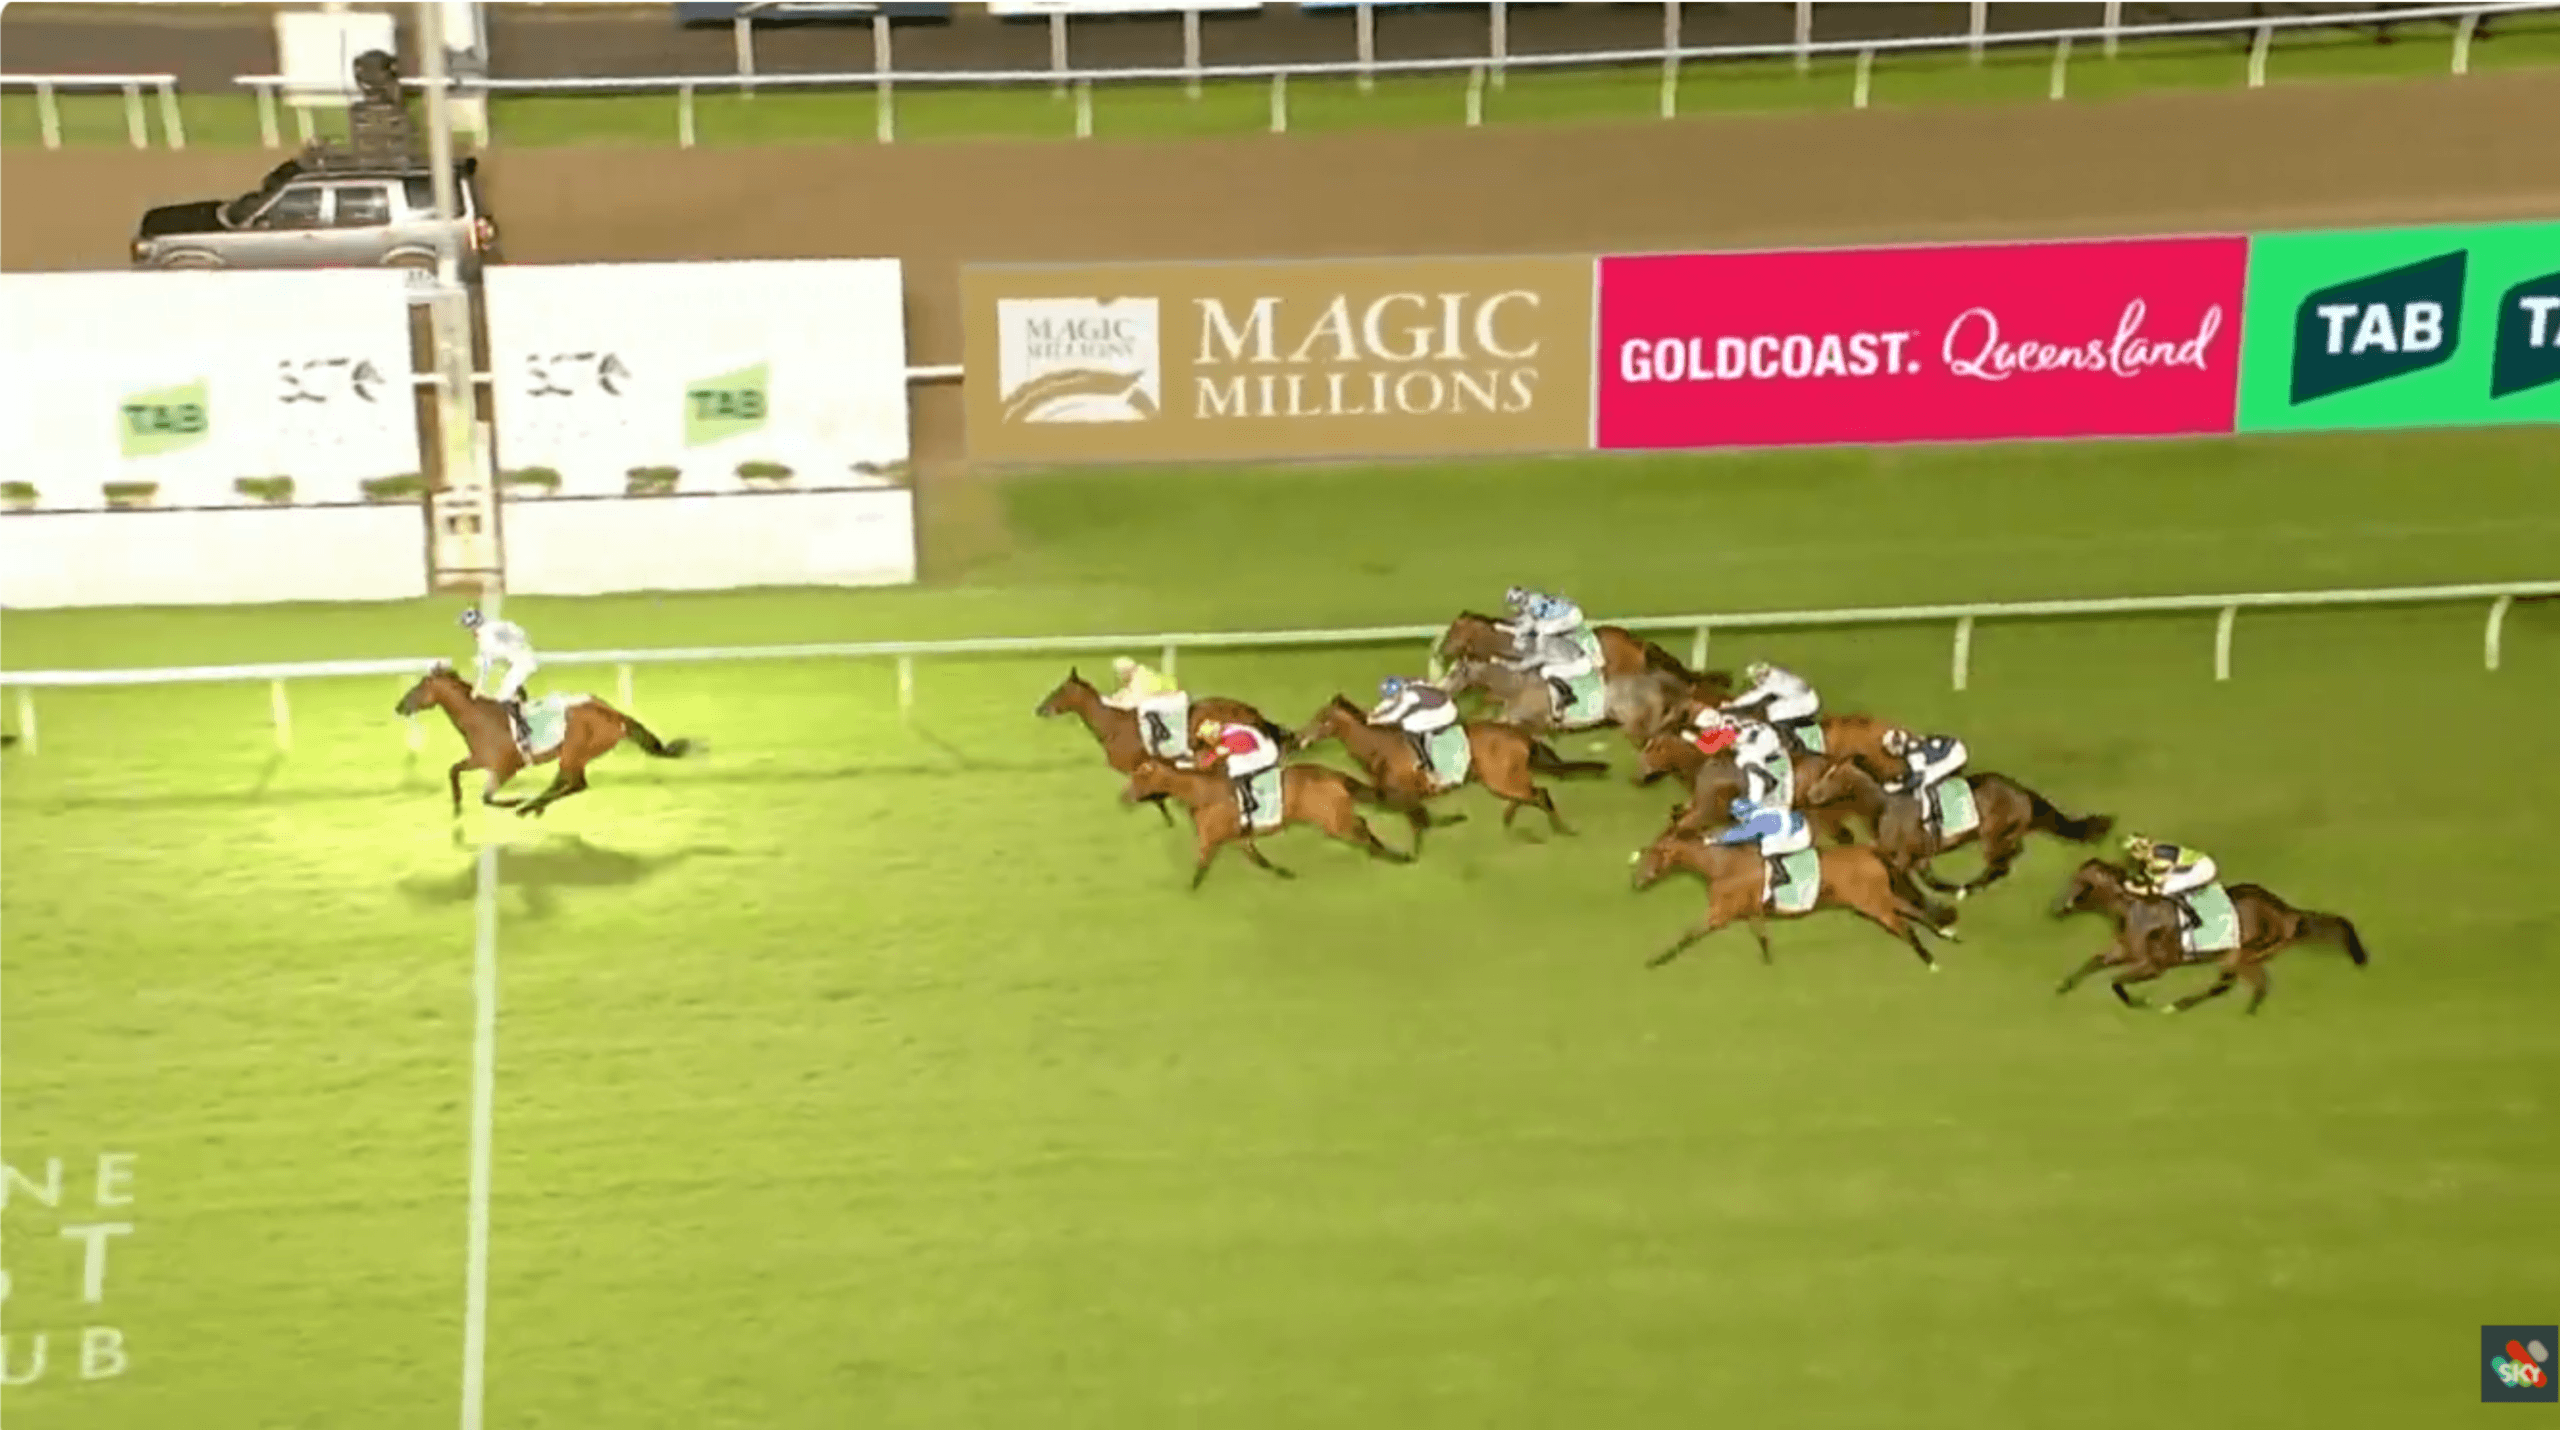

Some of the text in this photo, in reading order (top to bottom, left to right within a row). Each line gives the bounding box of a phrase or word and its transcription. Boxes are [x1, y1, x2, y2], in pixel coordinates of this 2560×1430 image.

[1025, 316, 1137, 342] MAGIC
[1193, 290, 1541, 365] MAGIC
[1942, 298, 2223, 381] Queensland
[2316, 301, 2445, 356] TAB
[2518, 295, 2560, 349] T
[686, 387, 767, 422] TAB
[1195, 368, 1540, 418] MILLIONS
[122, 402, 208, 437] TAB
